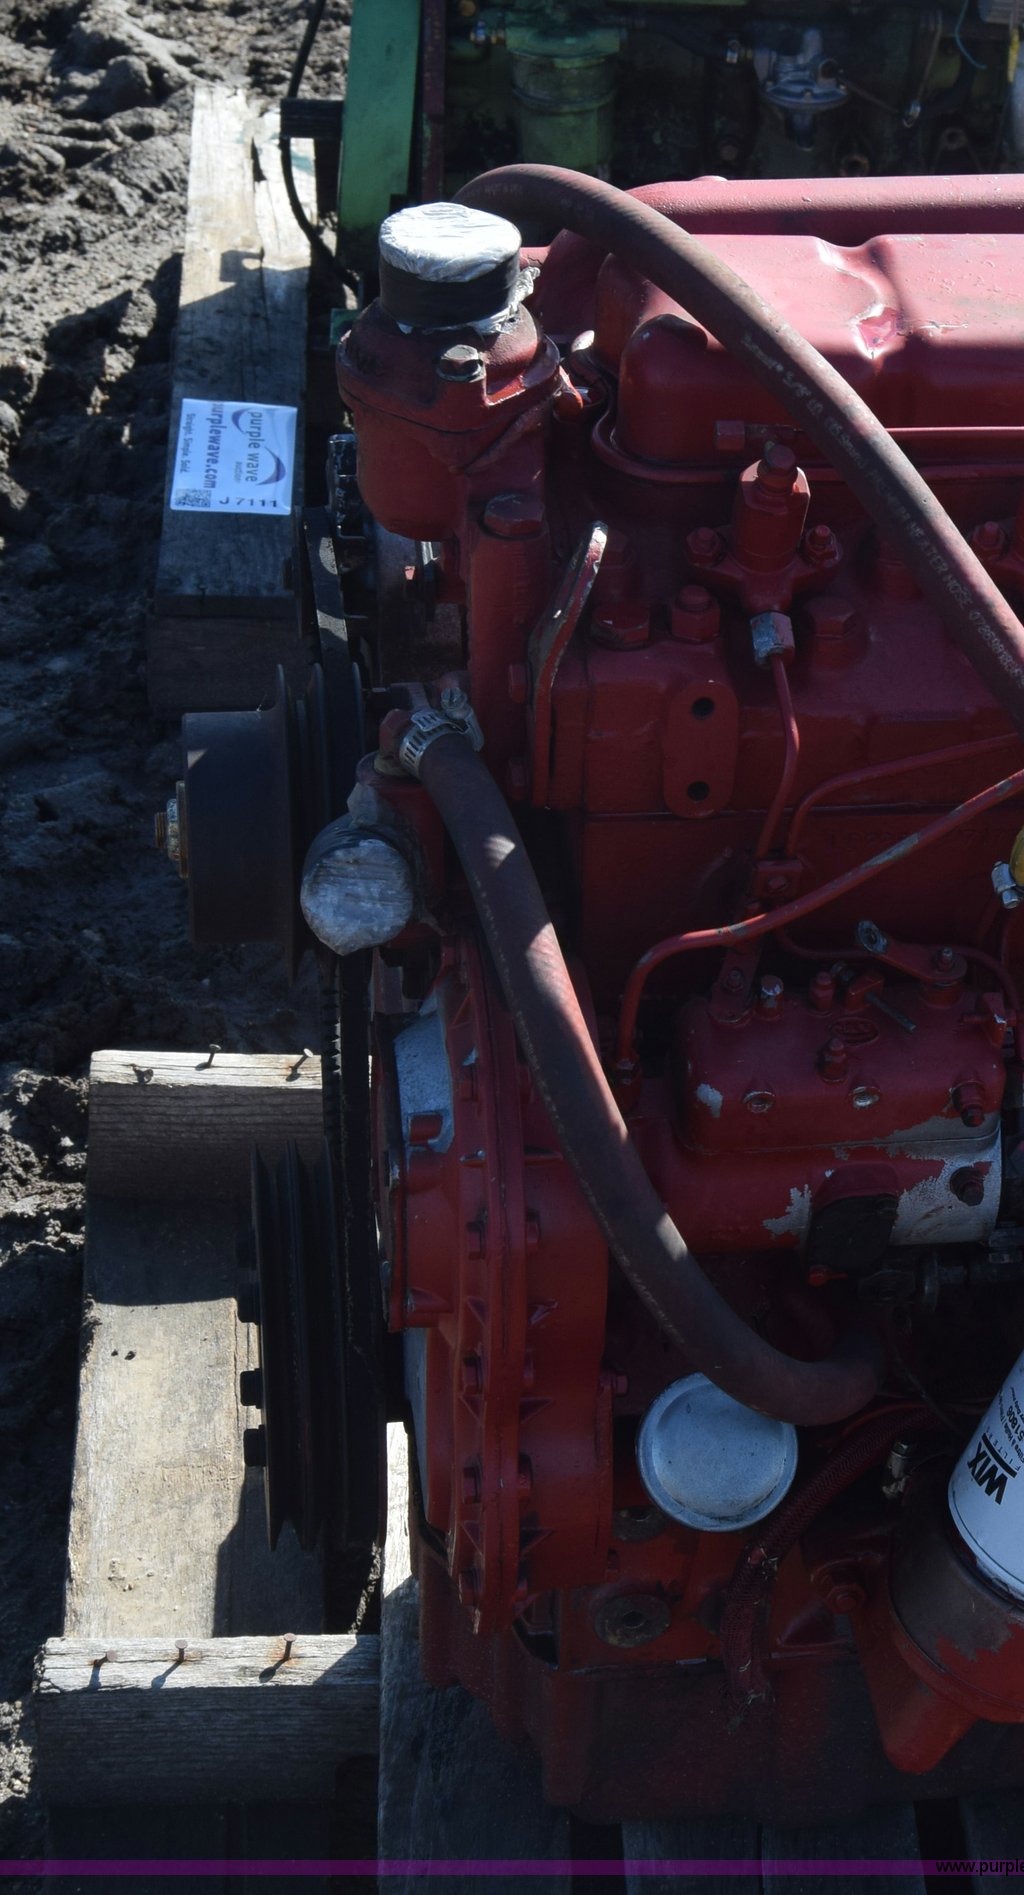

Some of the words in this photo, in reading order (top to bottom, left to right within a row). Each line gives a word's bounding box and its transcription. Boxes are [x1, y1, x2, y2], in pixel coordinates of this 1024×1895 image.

[245, 411, 265, 449] purple
[245, 452, 260, 482] wave
[236, 497, 277, 508] 7111
[943, 574, 972, 609] HOSE
[967, 1440, 1008, 1505] WIX
